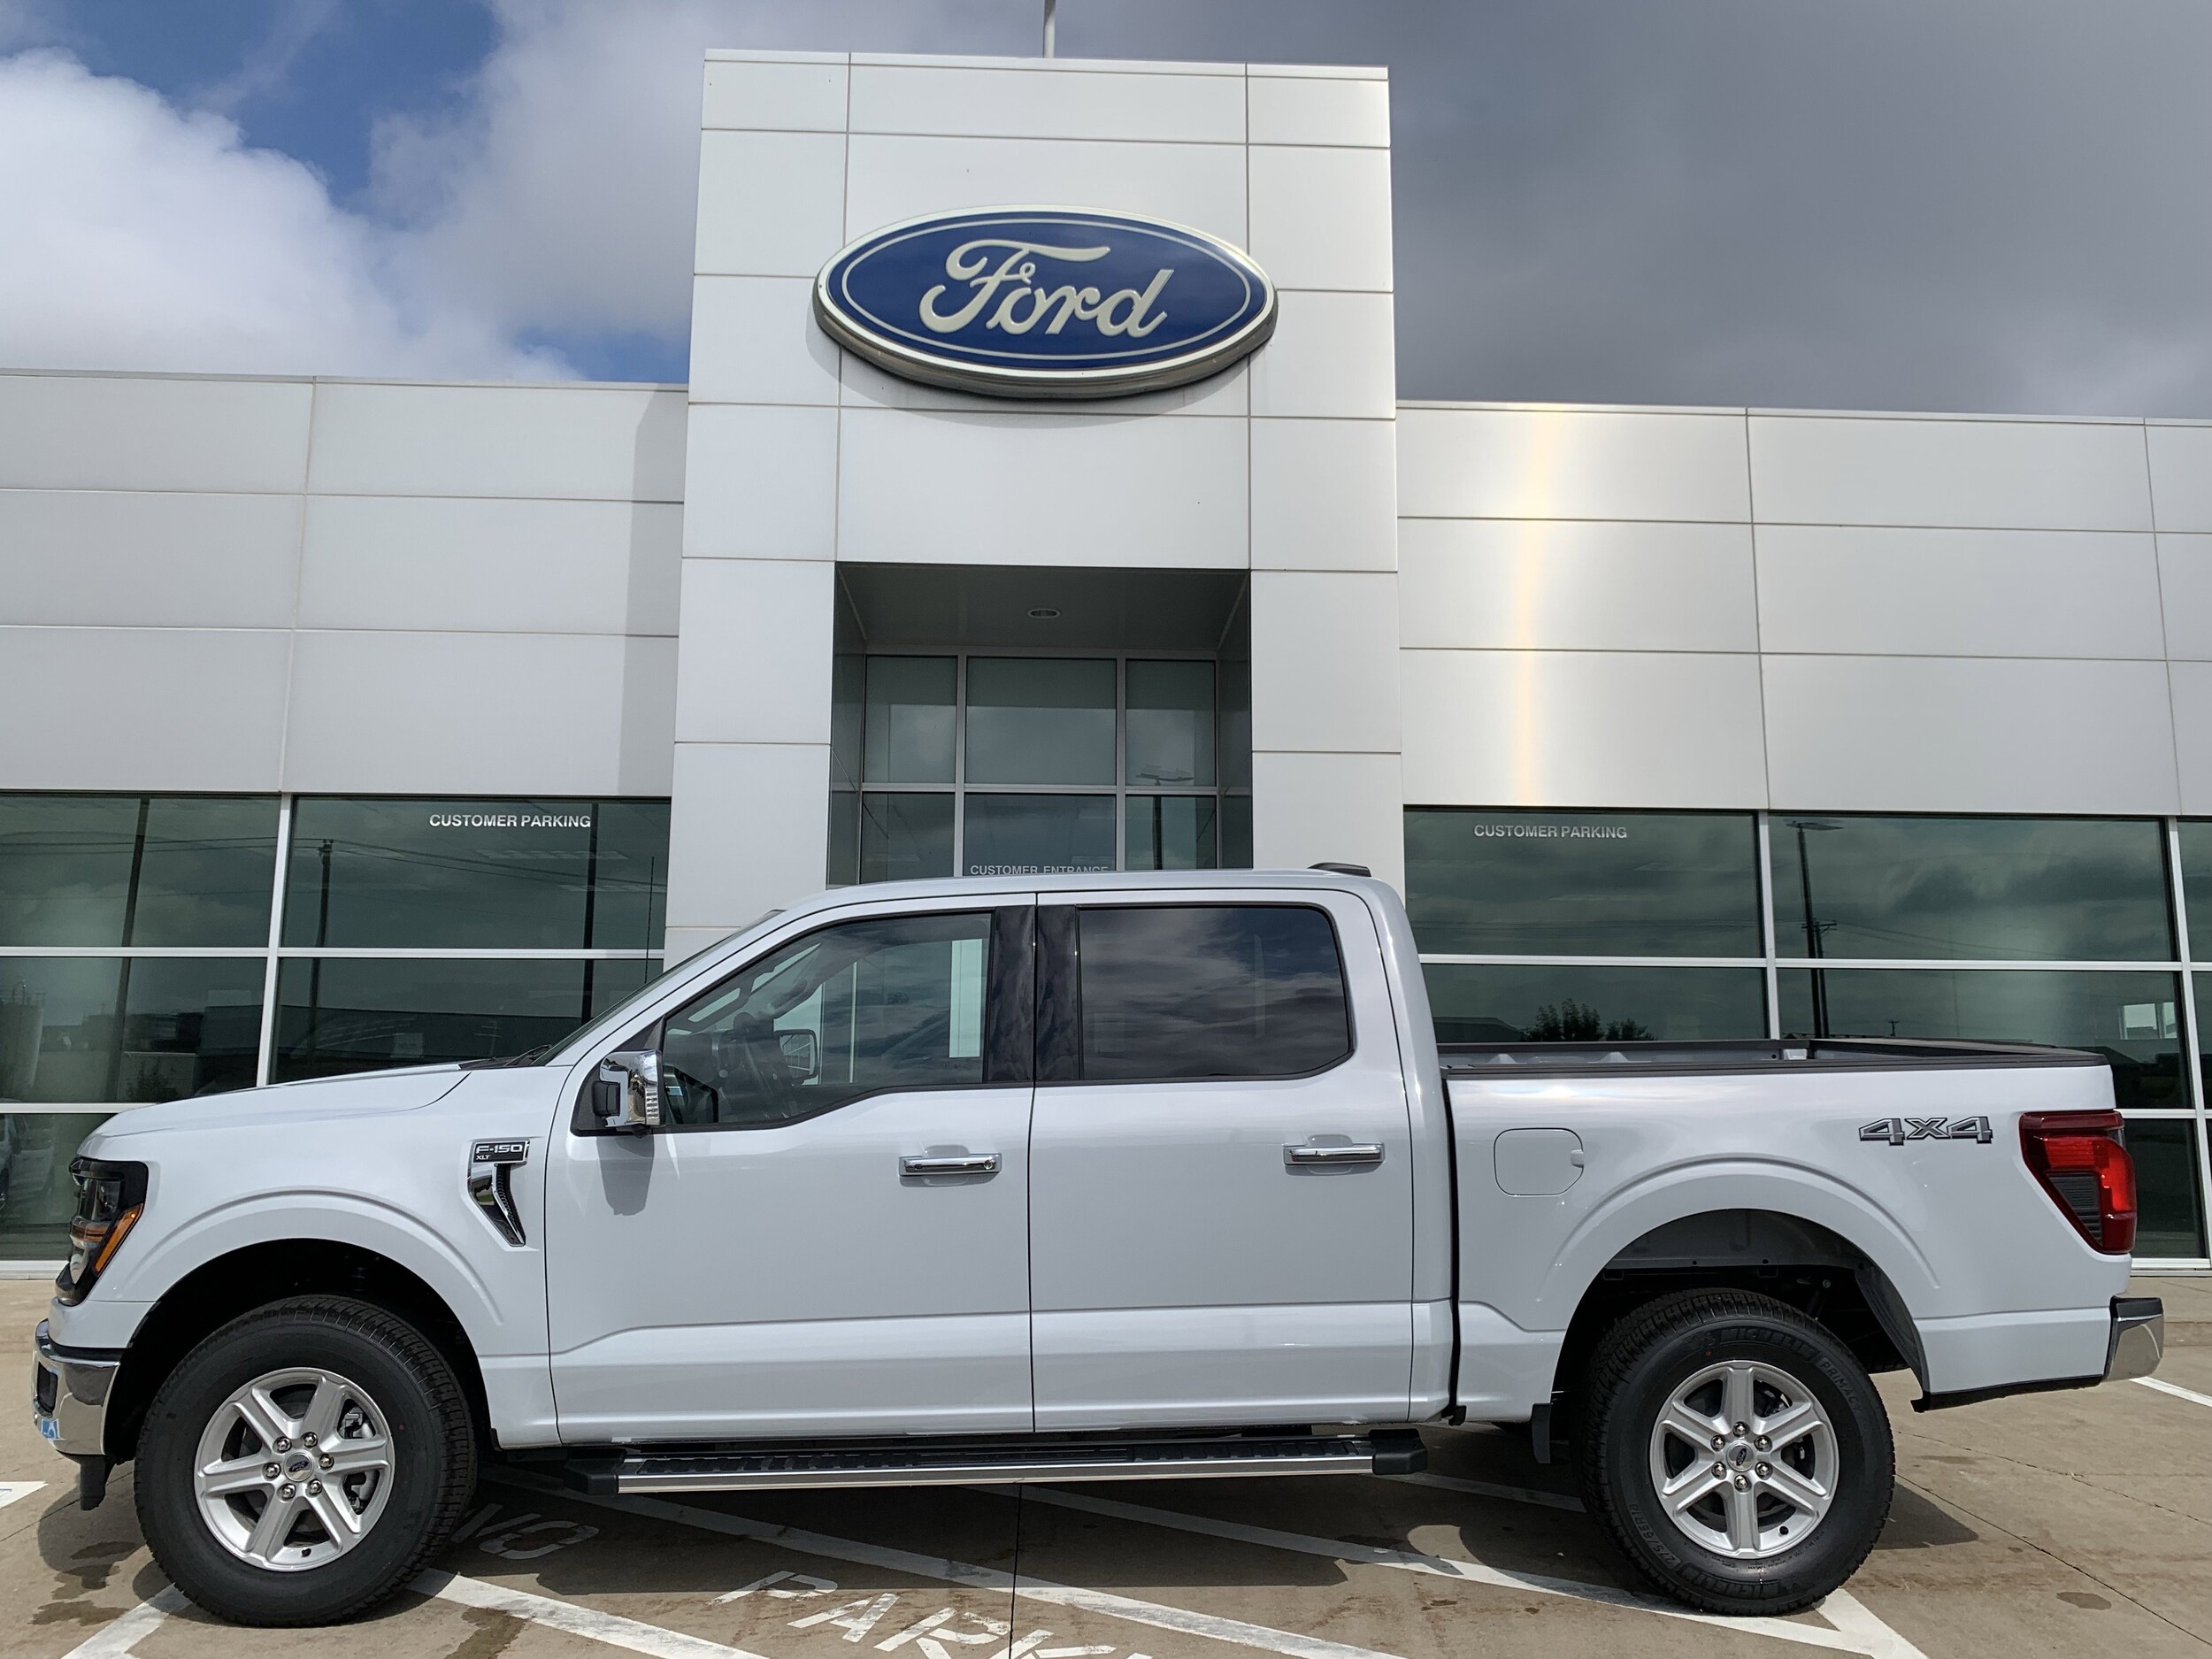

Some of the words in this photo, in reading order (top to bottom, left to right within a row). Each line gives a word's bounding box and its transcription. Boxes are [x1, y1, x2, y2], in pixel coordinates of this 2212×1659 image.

[919, 239, 1174, 337] Ford
[429, 814, 517, 827] CUSTOMER
[520, 816, 591, 828] PARKING
[1473, 825, 1557, 837] CUSTOMER
[1561, 826, 1628, 838] PARKING
[970, 864, 1038, 875] CUSTOMER
[476, 1144, 523, 1154] F-150
[707, 1571, 1153, 1659] PARK
